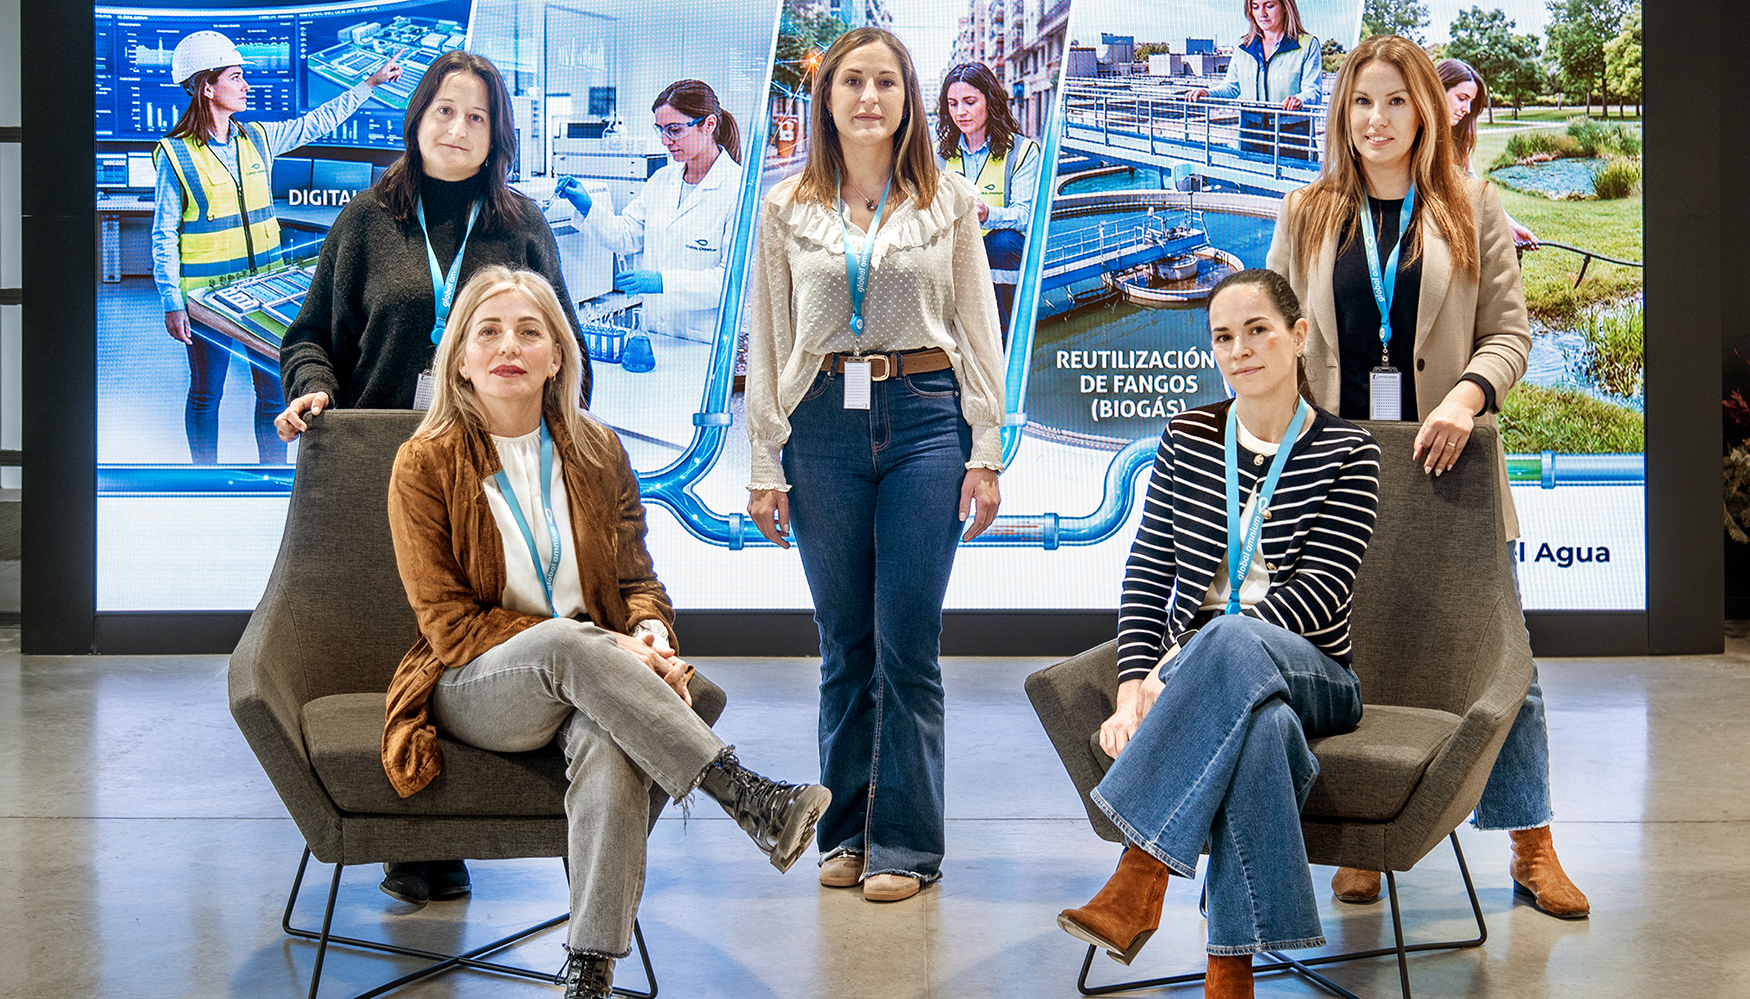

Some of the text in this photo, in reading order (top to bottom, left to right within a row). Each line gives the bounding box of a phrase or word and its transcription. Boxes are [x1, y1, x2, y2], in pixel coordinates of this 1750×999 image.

[856, 268, 866, 293] global
[1368, 249, 1385, 303] global omnium
[442, 284, 453, 308] global
[1056, 346, 1215, 369] REUTILIZACIÓN
[1080, 374, 1199, 394] DE FANGOS
[1091, 396, 1187, 421] (BIOGÁS)
[546, 526, 560, 591] global omnium
[1237, 514, 1262, 581] global omnium
[1534, 542, 1610, 568] Agua
